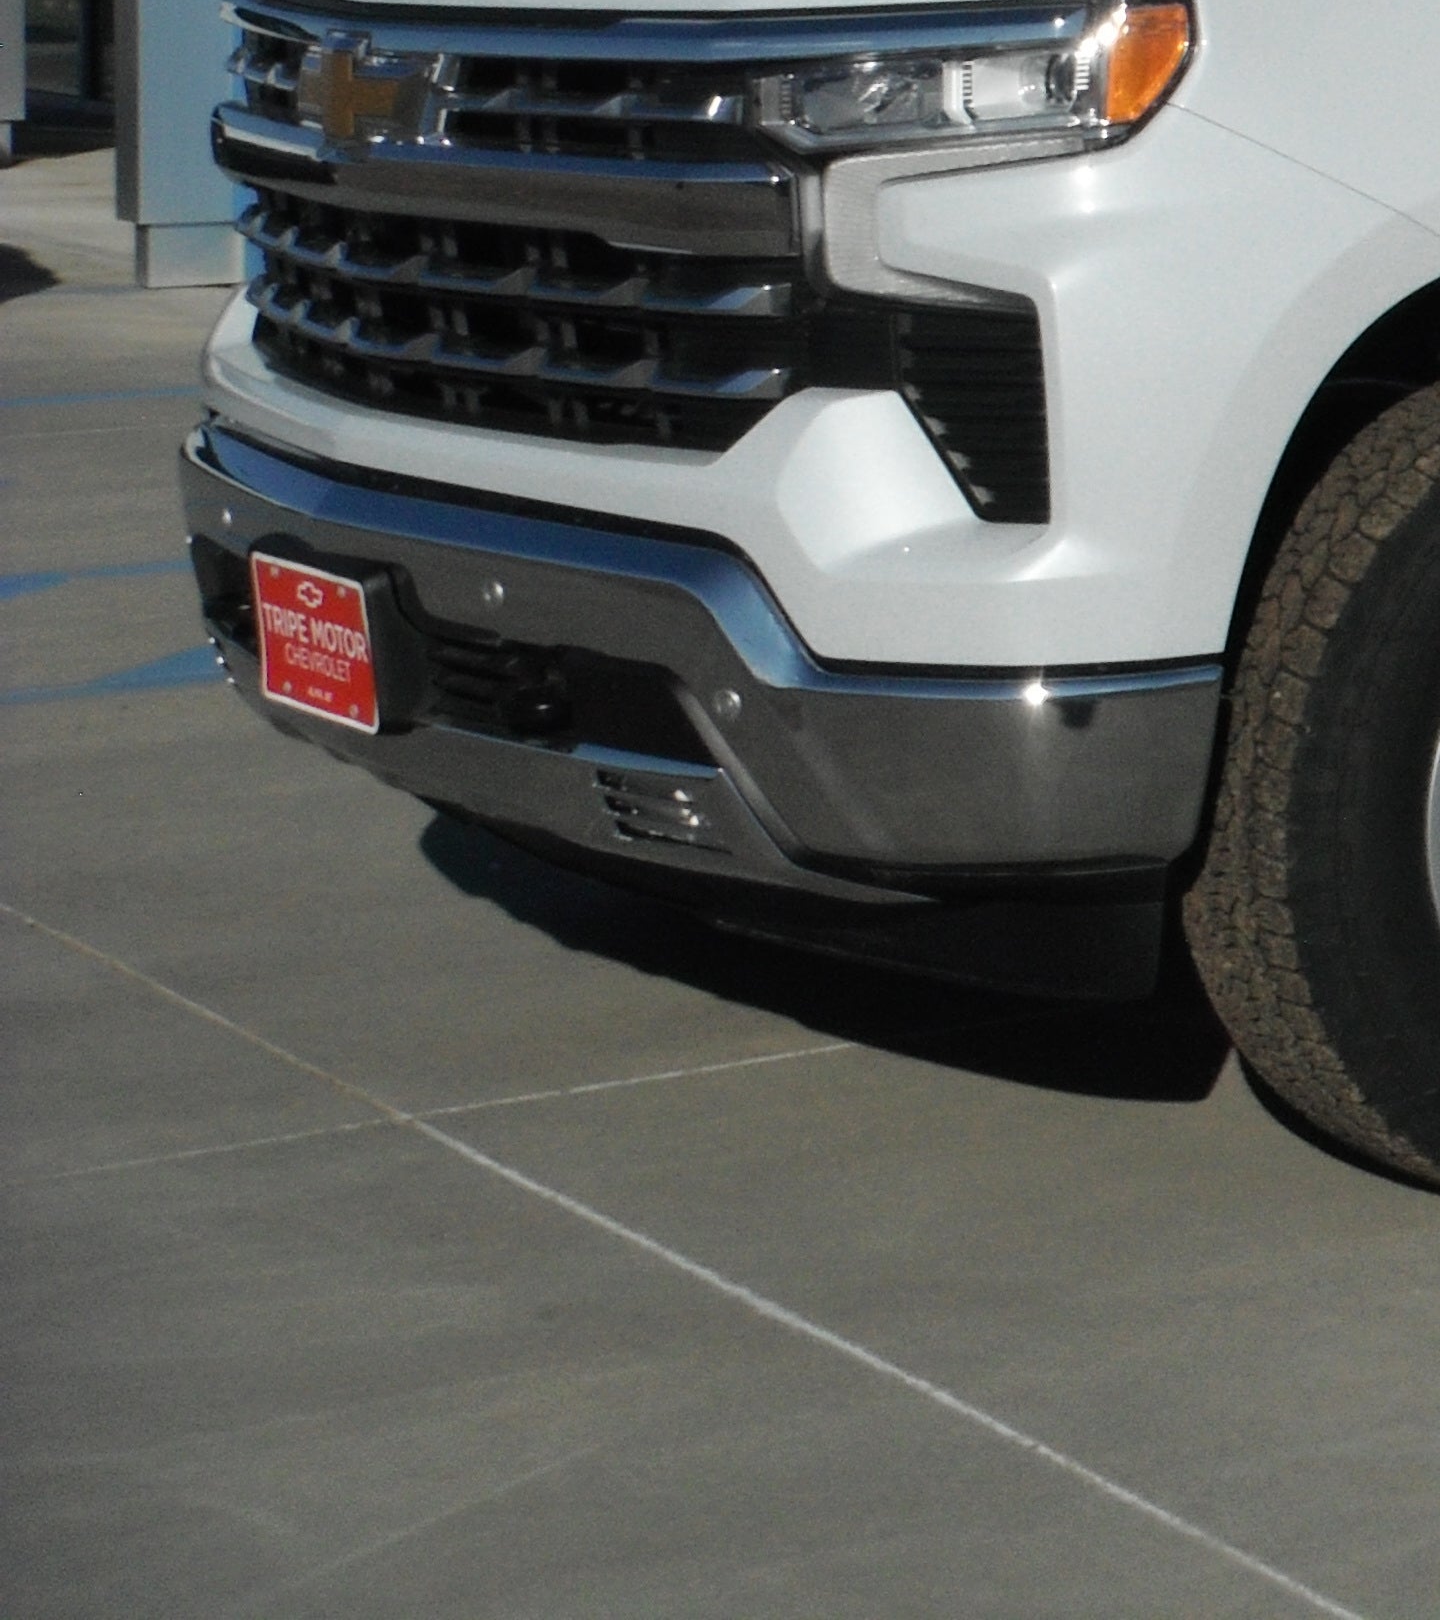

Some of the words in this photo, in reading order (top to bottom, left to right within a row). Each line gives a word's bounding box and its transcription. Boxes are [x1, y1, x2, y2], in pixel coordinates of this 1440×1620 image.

[262, 602, 308, 643] TRIPE
[310, 617, 369, 663] MOTOR
[285, 643, 351, 683] CHEVROLET
